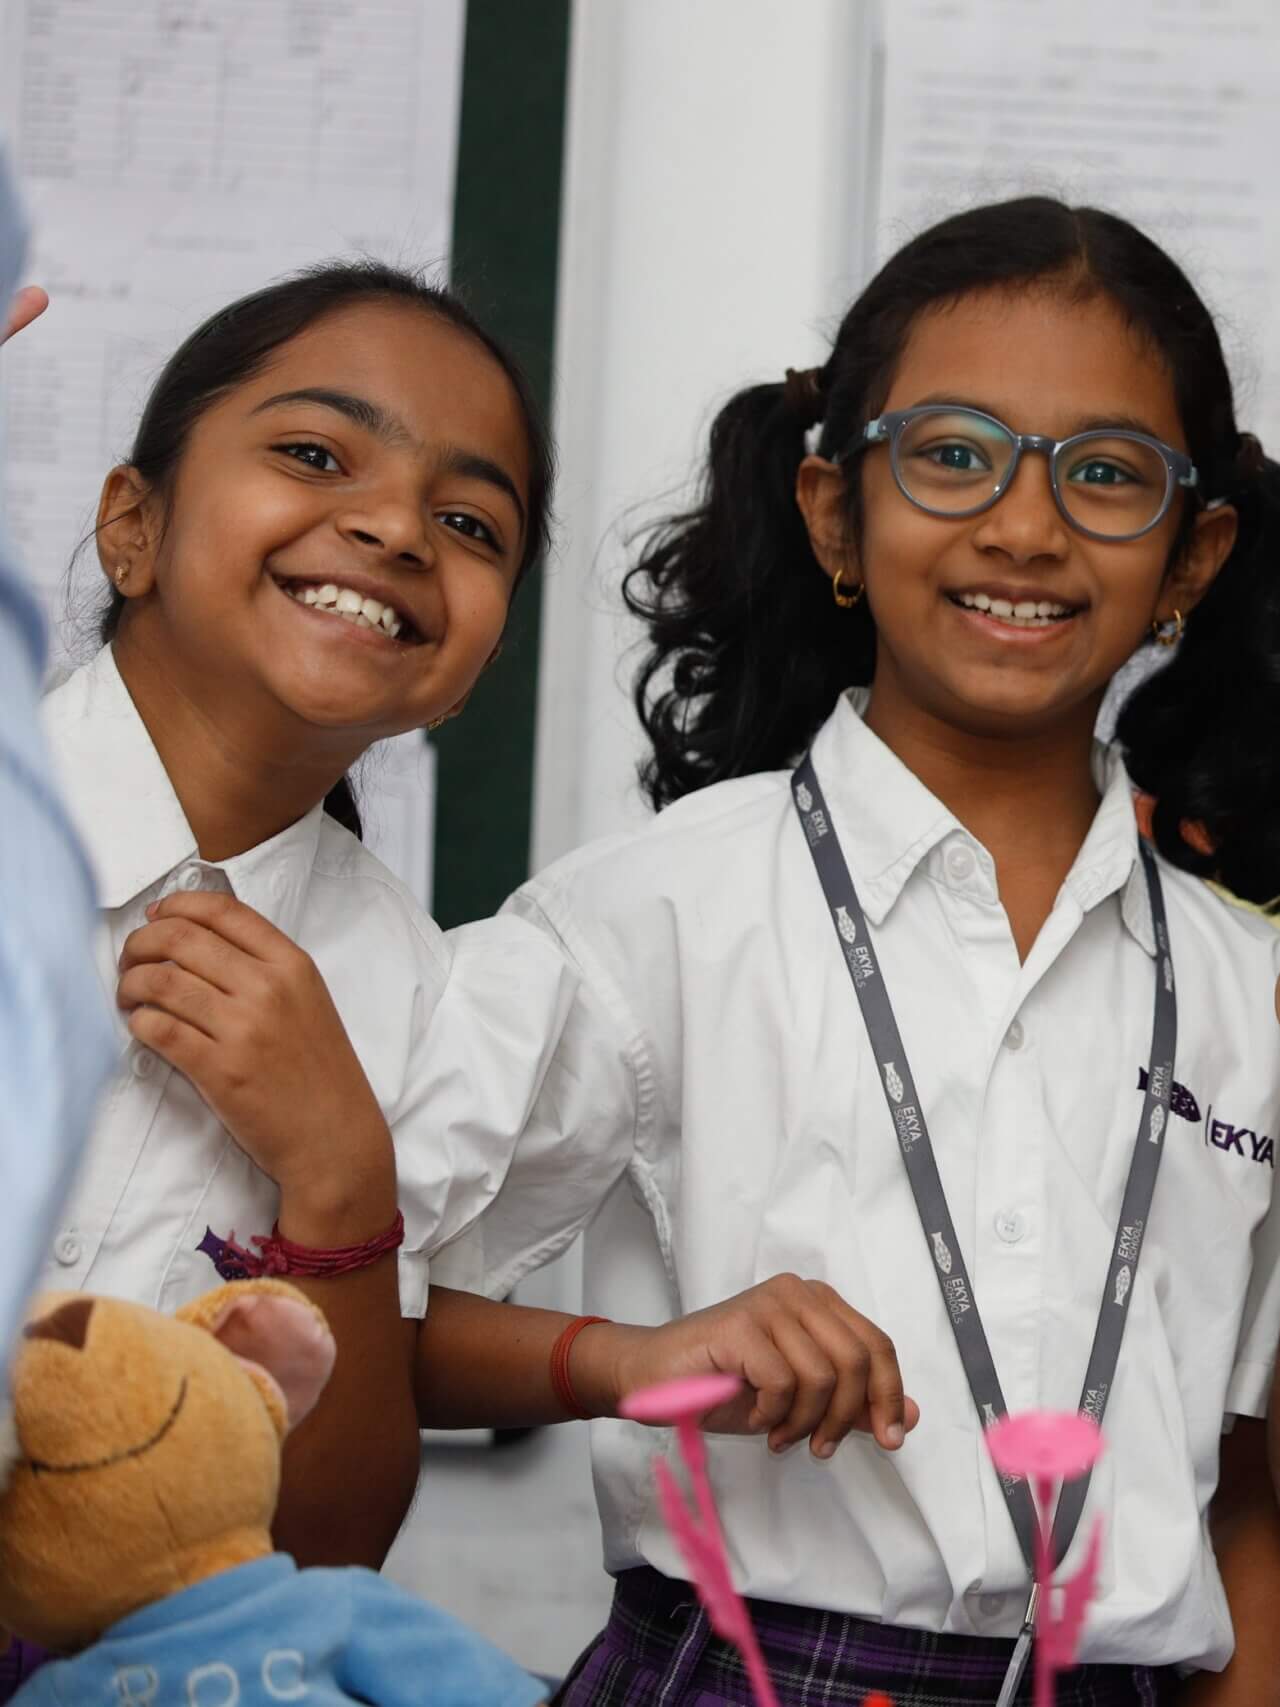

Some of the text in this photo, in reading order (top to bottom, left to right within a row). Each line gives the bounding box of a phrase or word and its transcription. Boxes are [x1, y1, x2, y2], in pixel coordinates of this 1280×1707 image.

[810, 809, 829, 837] EKYA
[855, 946, 875, 978] EKYA
[1151, 1066, 1164, 1097] EKYA
[895, 1109, 913, 1153] SCHOOLS
[903, 1106, 922, 1142] EKYA
[1211, 1119, 1275, 1169] EKYA
[1118, 1226, 1134, 1258] EKYA
[943, 1279, 962, 1324] SCHOOLS
[951, 1278, 971, 1313] EKYA
